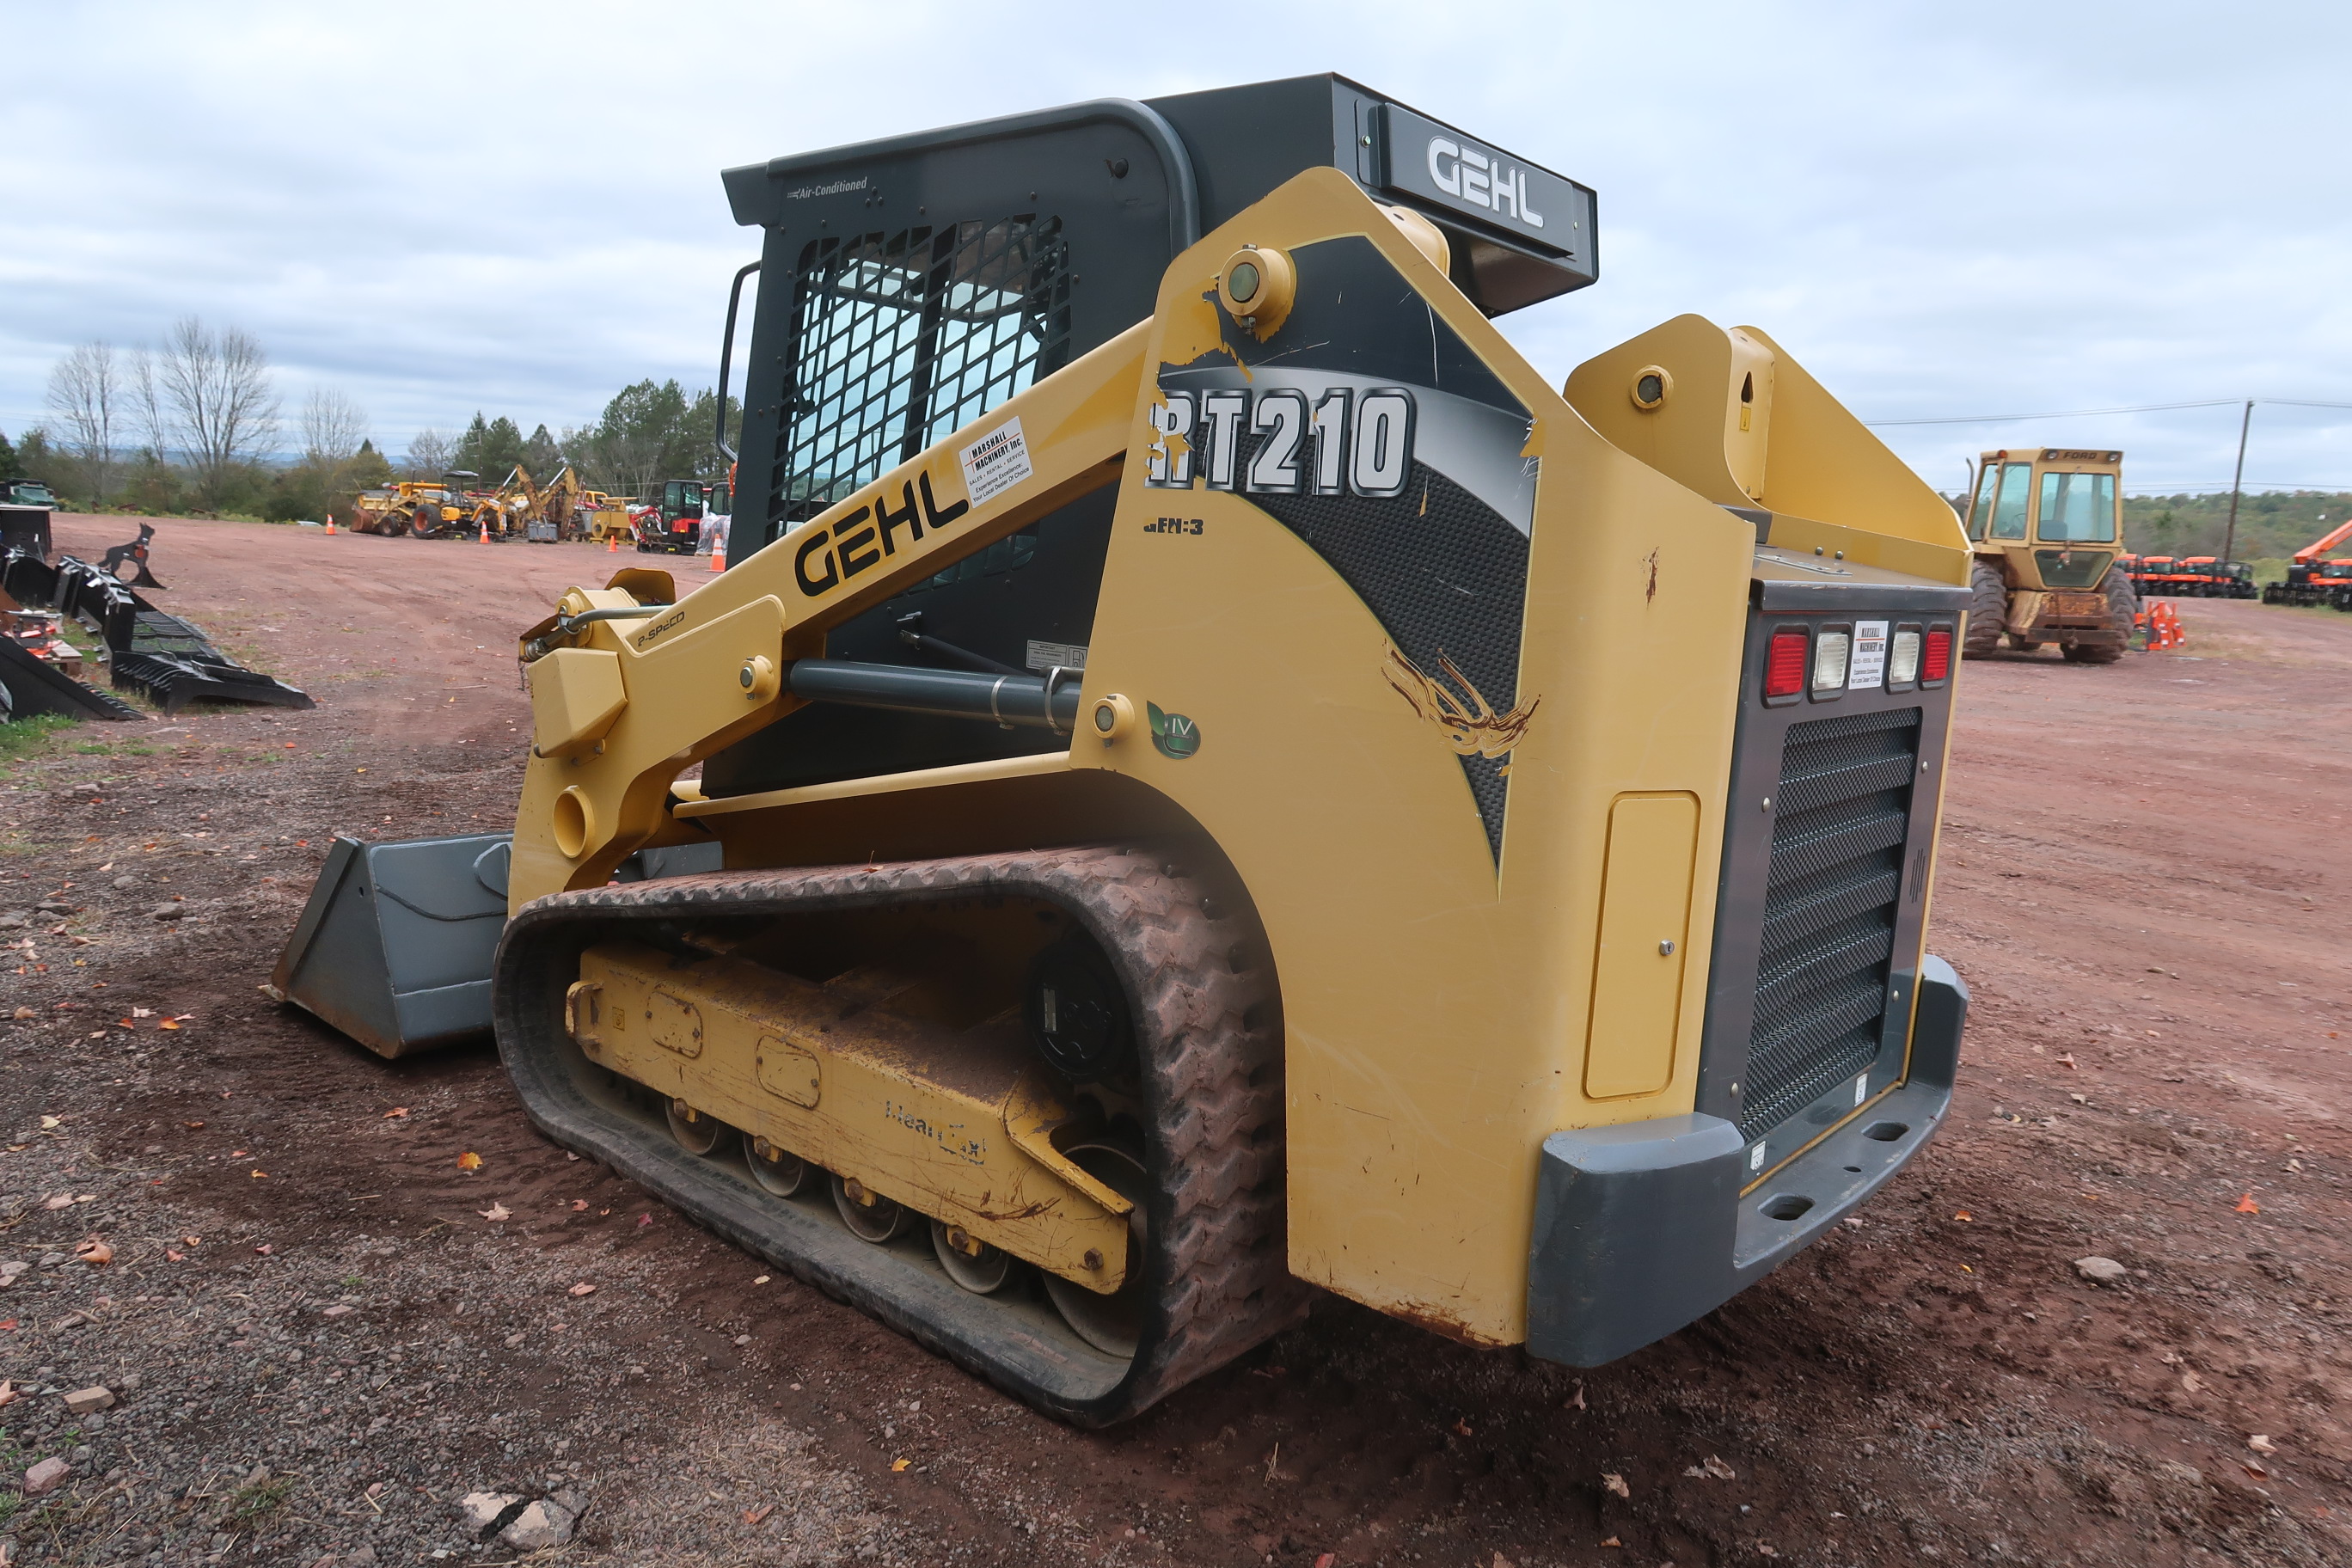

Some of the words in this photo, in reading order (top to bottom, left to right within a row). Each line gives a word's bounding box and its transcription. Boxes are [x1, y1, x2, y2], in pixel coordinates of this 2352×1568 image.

[799, 176, 867, 199] Air-Conditioned
[1428, 136, 1544, 228] GEHL
[971, 431, 1007, 459] MARSHALL
[1009, 438, 1023, 450] Inc.
[1144, 387, 1417, 498] RT210
[2063, 451, 2098, 460] FORD
[969, 475, 983, 487] SALES
[986, 463, 1003, 476] RENTAL
[1006, 449, 1026, 464] SERVICE
[973, 494, 983, 503] Your
[983, 487, 995, 498] Local
[995, 480, 1008, 490] Dealer
[1014, 467, 1030, 479] Choice
[975, 478, 998, 493] Experience
[794, 469, 970, 597] GEHL
[1172, 718, 1193, 735] IV
